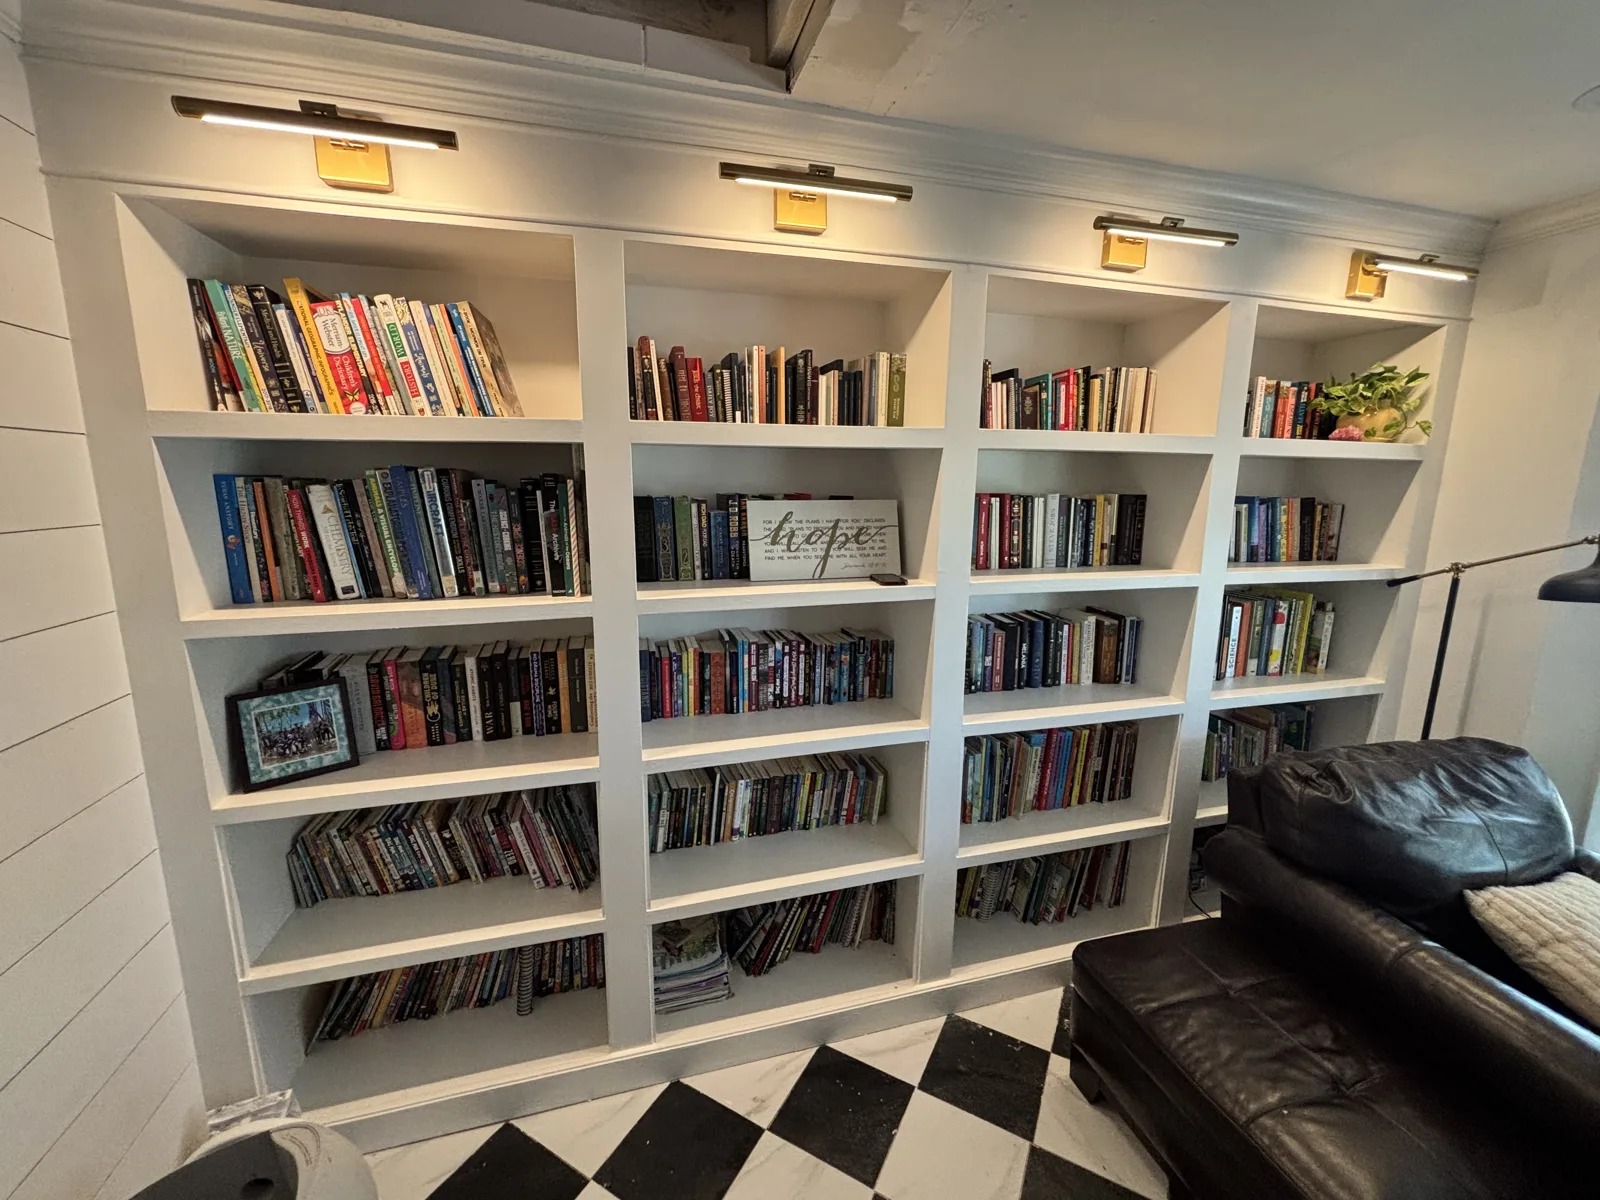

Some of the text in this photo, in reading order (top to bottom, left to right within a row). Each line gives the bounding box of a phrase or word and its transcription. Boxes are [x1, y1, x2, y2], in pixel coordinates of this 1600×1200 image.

[223, 328, 242, 361] NATURE
[306, 327, 322, 360] GEOGRAPHIC
[320, 319, 336, 348] Webster
[388, 324, 405, 357] WORLD
[251, 339, 271, 373] Universe
[271, 340, 282, 359] Health
[347, 336, 367, 378] ELEMENTARY
[332, 356, 351, 392] Dictionary
[402, 362, 419, 396] HISTORY
[295, 509, 306, 531] THINGS
[301, 531, 311, 549] WORK
[379, 515, 390, 539] VISUAL
[729, 516, 738, 538] ROBB
[327, 515, 352, 576] CHEMISTRY
[552, 533, 560, 561] Archives
[750, 511, 898, 578] hope
[455, 555, 465, 574] SKILLS
[1228, 638, 1237, 669] SCIENCE
[422, 672, 432, 702] CHILDREN
[429, 673, 439, 699] OF DUNE
[485, 712, 494, 734] WAR
[503, 848, 518, 865] ZERO
